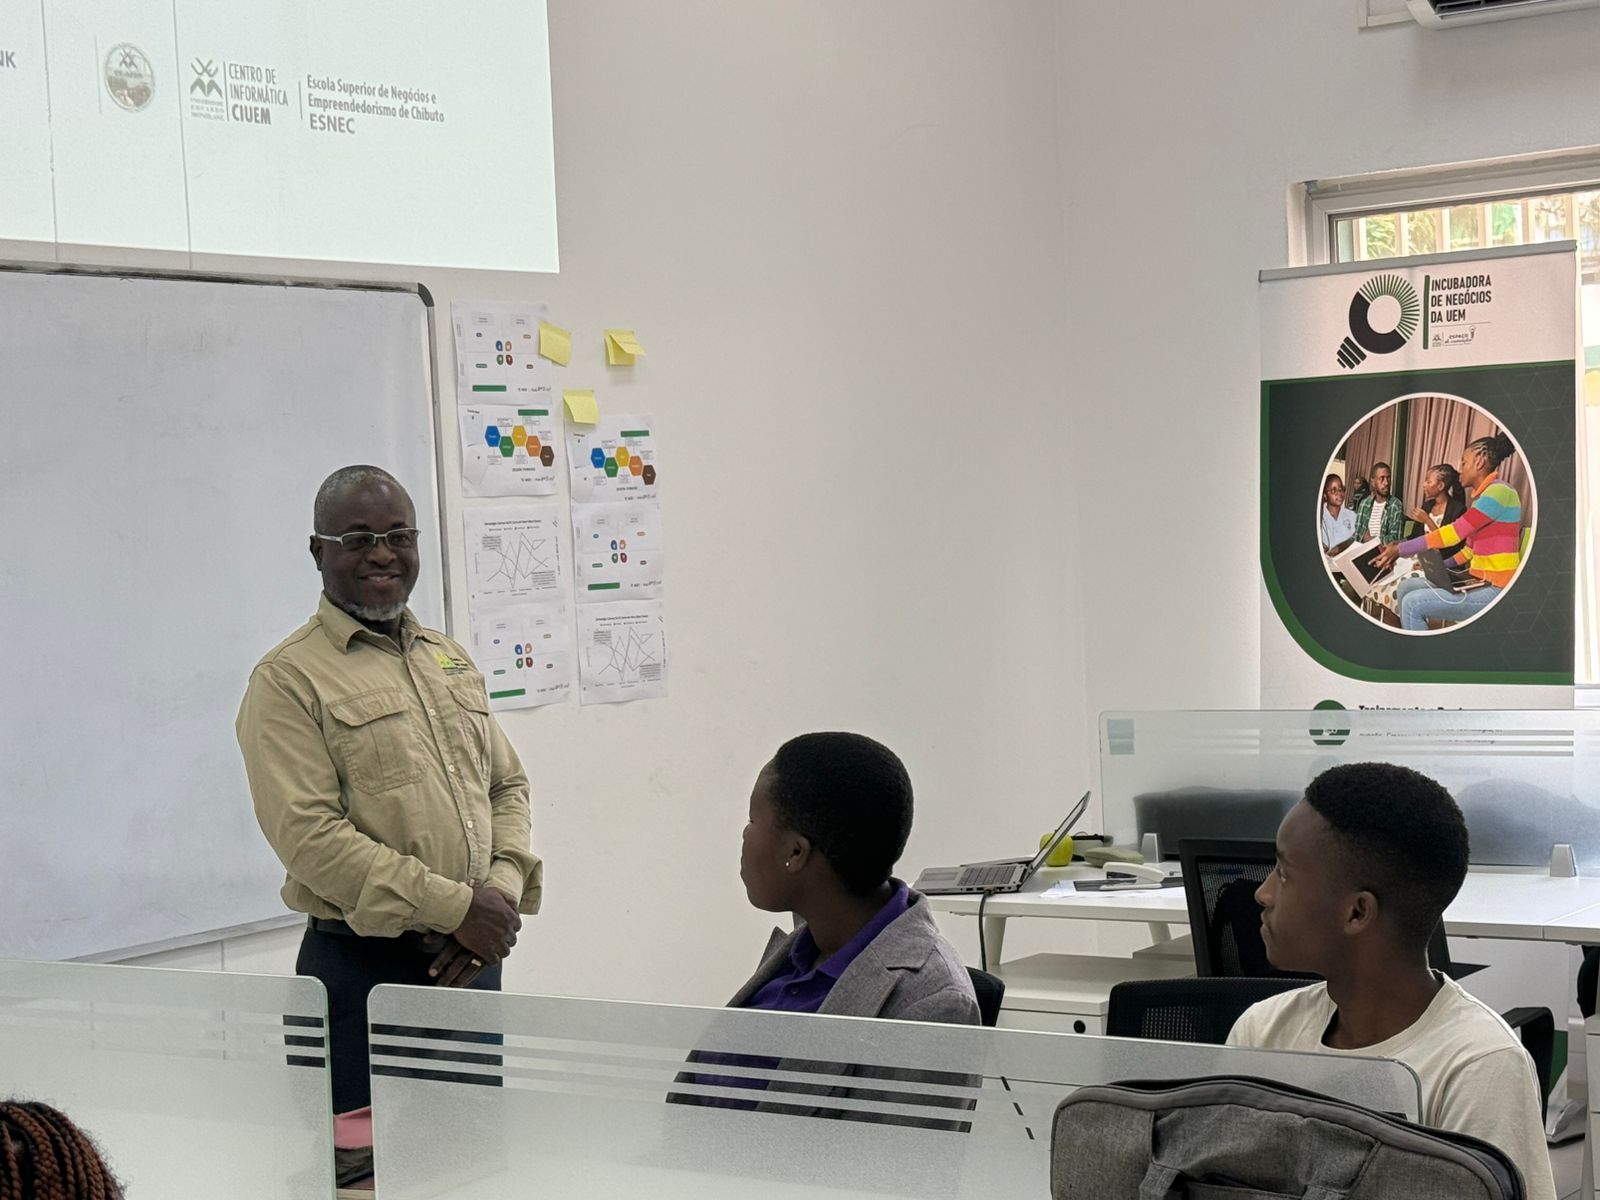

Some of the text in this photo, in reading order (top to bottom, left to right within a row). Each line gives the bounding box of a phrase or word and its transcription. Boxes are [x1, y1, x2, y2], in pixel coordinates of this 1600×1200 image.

[228, 63, 277, 85] CENTRO DE
[230, 83, 289, 107] INFORMÁTICA
[306, 74, 437, 104] Escola Superior de Negócios e
[231, 103, 272, 125] CIUEM
[308, 93, 445, 123] Empreendedorismo de Chibuto
[309, 113, 356, 135] ESNEC
[1431, 274, 1492, 292] INCUBADORA
[1431, 289, 1492, 307] DE NEGÓCIOS
[1431, 308, 1466, 323] DA UEM
